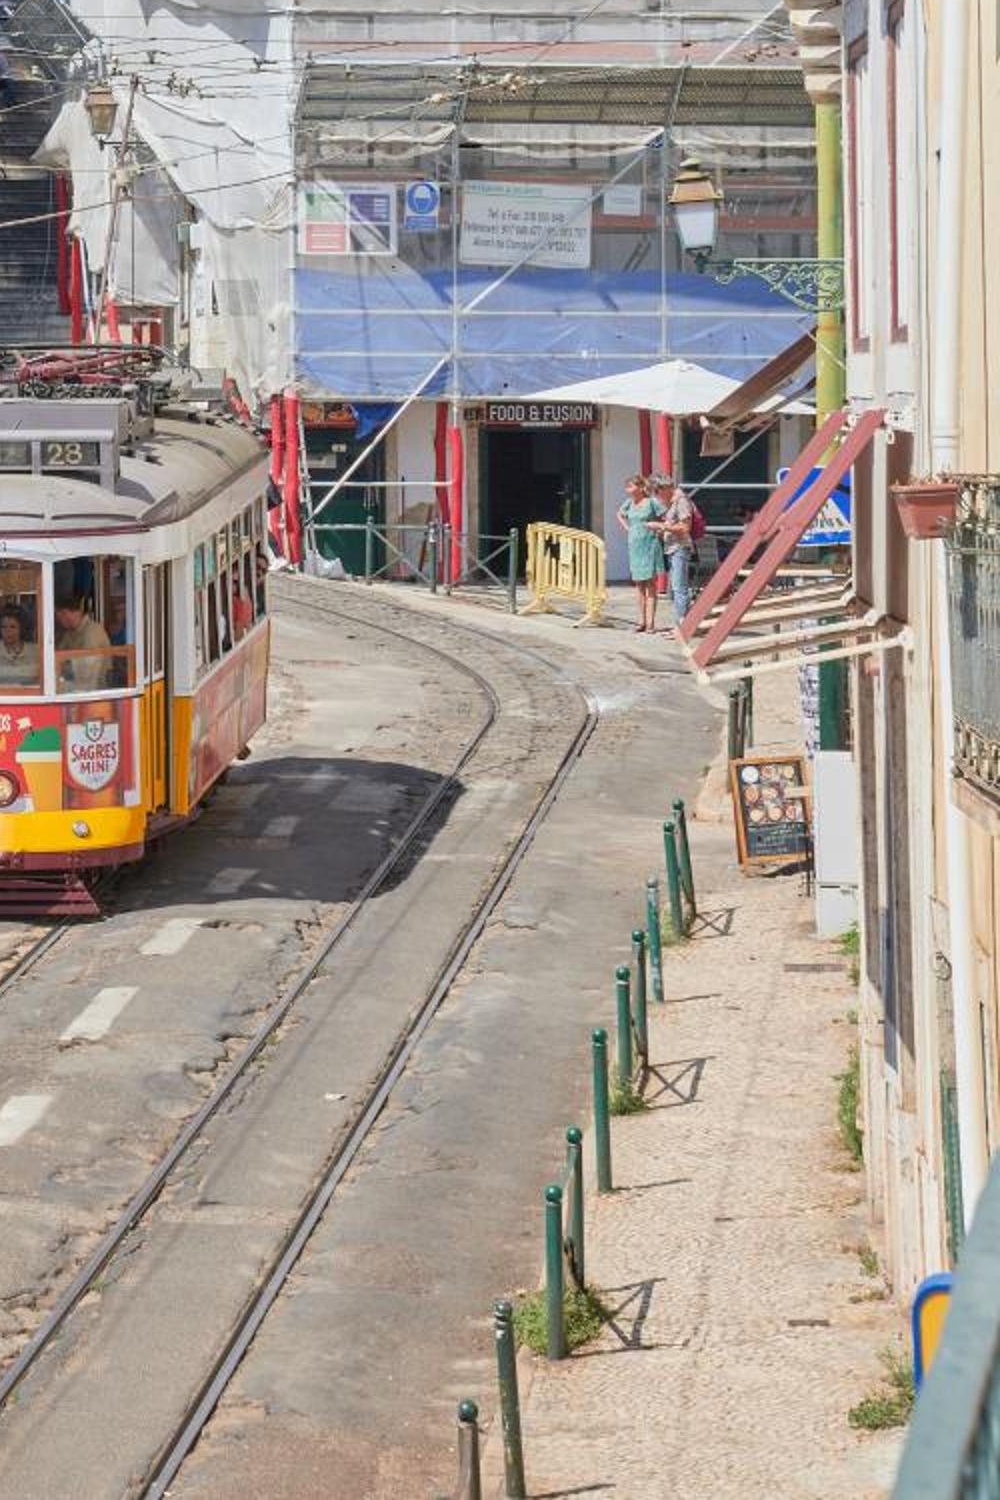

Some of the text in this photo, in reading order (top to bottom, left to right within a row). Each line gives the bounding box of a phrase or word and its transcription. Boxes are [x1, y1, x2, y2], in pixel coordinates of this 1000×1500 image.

[489, 405, 594, 421] FOOD & FUSION
[47, 443, 84, 465] 28
[71, 741, 117, 762] SAGRES
